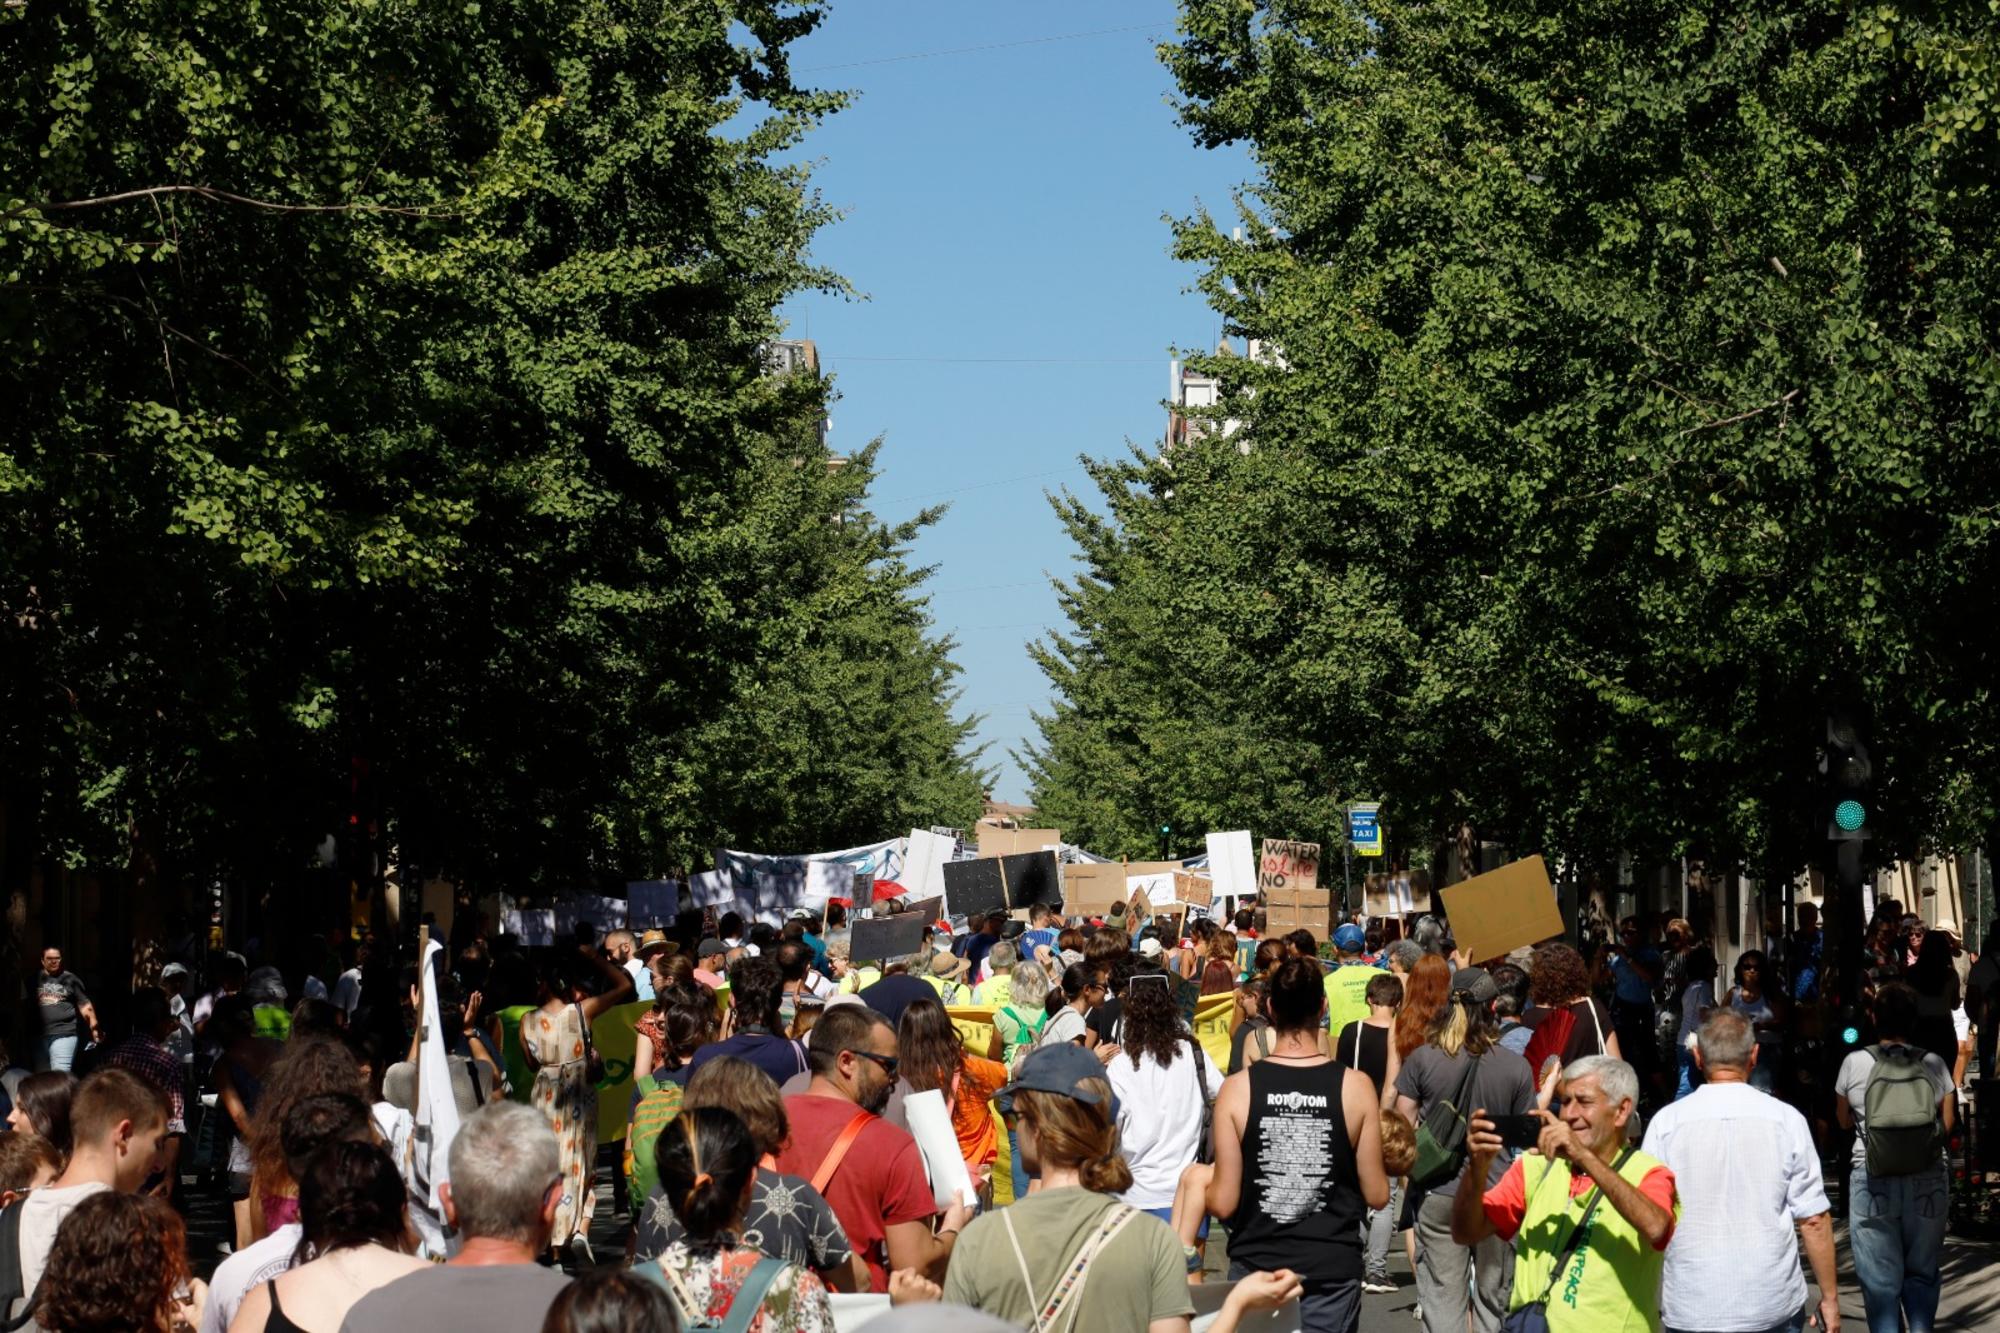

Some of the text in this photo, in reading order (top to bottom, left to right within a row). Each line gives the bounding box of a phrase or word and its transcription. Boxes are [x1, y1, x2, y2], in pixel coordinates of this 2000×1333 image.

[1352, 829, 1373, 838] TAXI
[1264, 839, 1319, 861] WATER
[1261, 872, 1285, 888] NO
